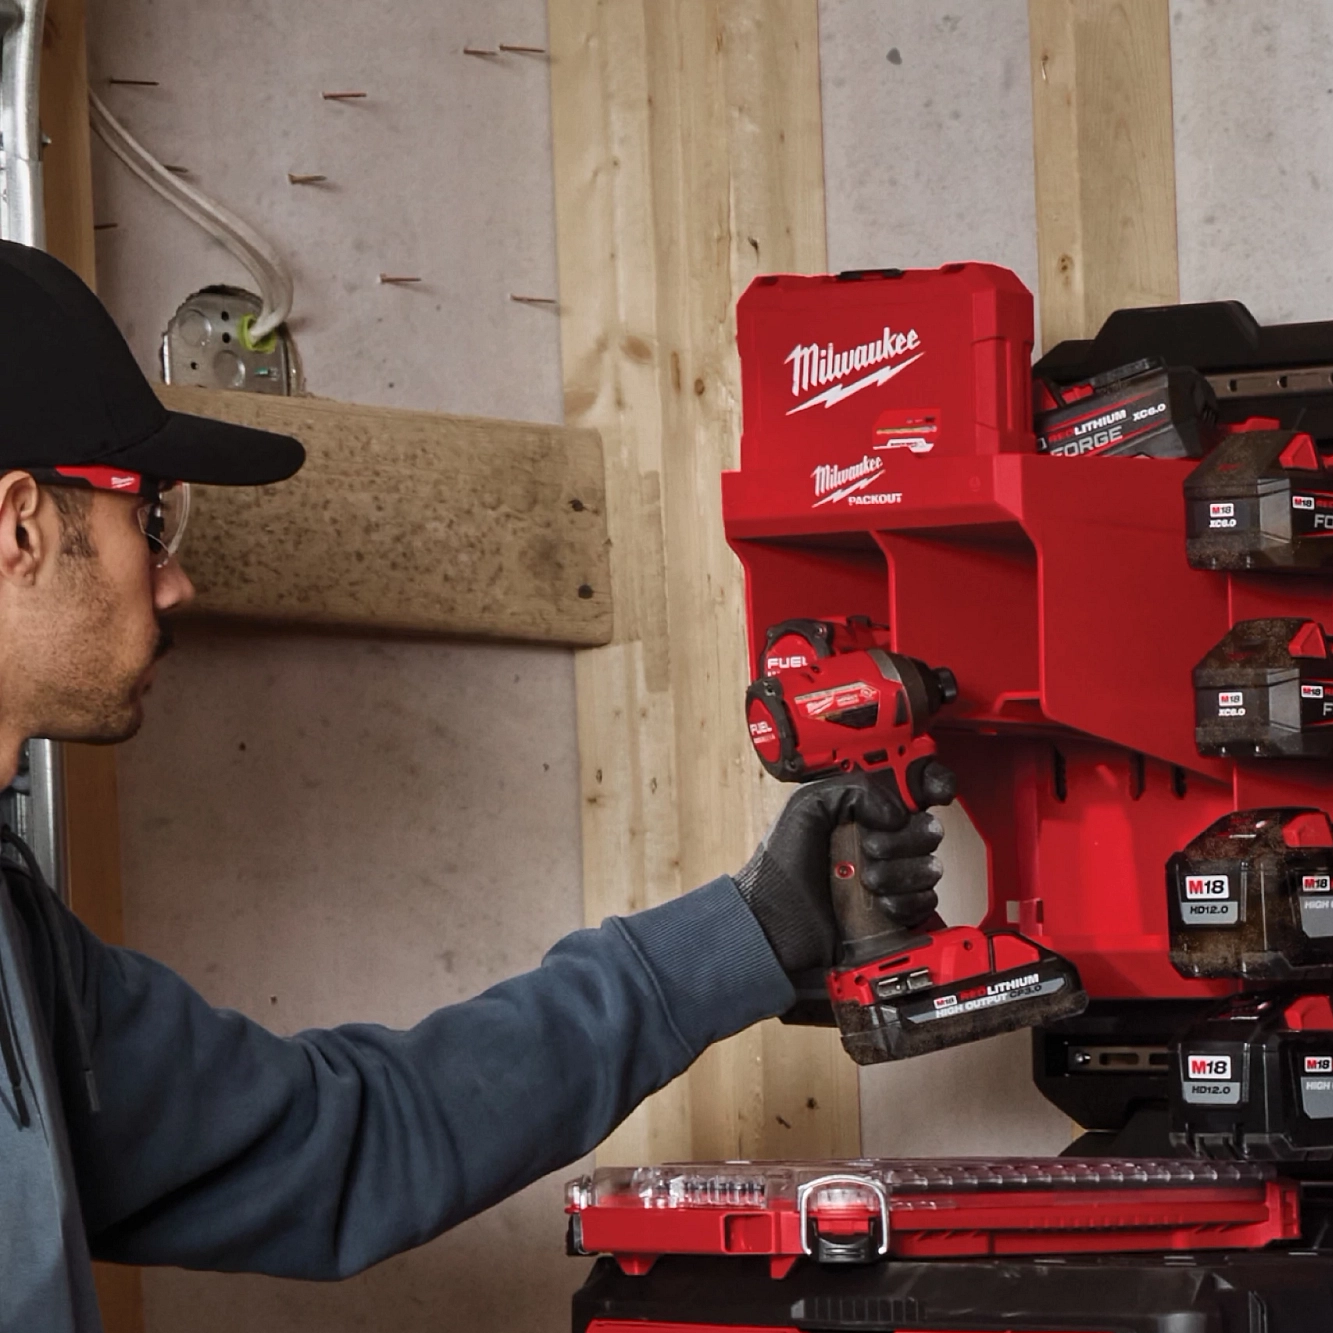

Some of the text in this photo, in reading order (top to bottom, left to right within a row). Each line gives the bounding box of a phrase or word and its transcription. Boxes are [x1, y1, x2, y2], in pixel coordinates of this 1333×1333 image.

[784, 326, 921, 397] Milwaukee
[810, 455, 884, 497] Milwaukee
[848, 492, 903, 506] PACKOUT
[1188, 879, 1225, 895] M18
[1189, 905, 1229, 915] HD12.0
[1304, 900, 1330, 910] HIGH
[935, 1005, 964, 1019] HIGH
[964, 992, 1008, 1011] OUTPUT
[1190, 1060, 1228, 1075] M18
[1305, 1059, 1331, 1071] M18
[1191, 1085, 1231, 1095] HD12.0
[1305, 1080, 1331, 1091] HIGH
